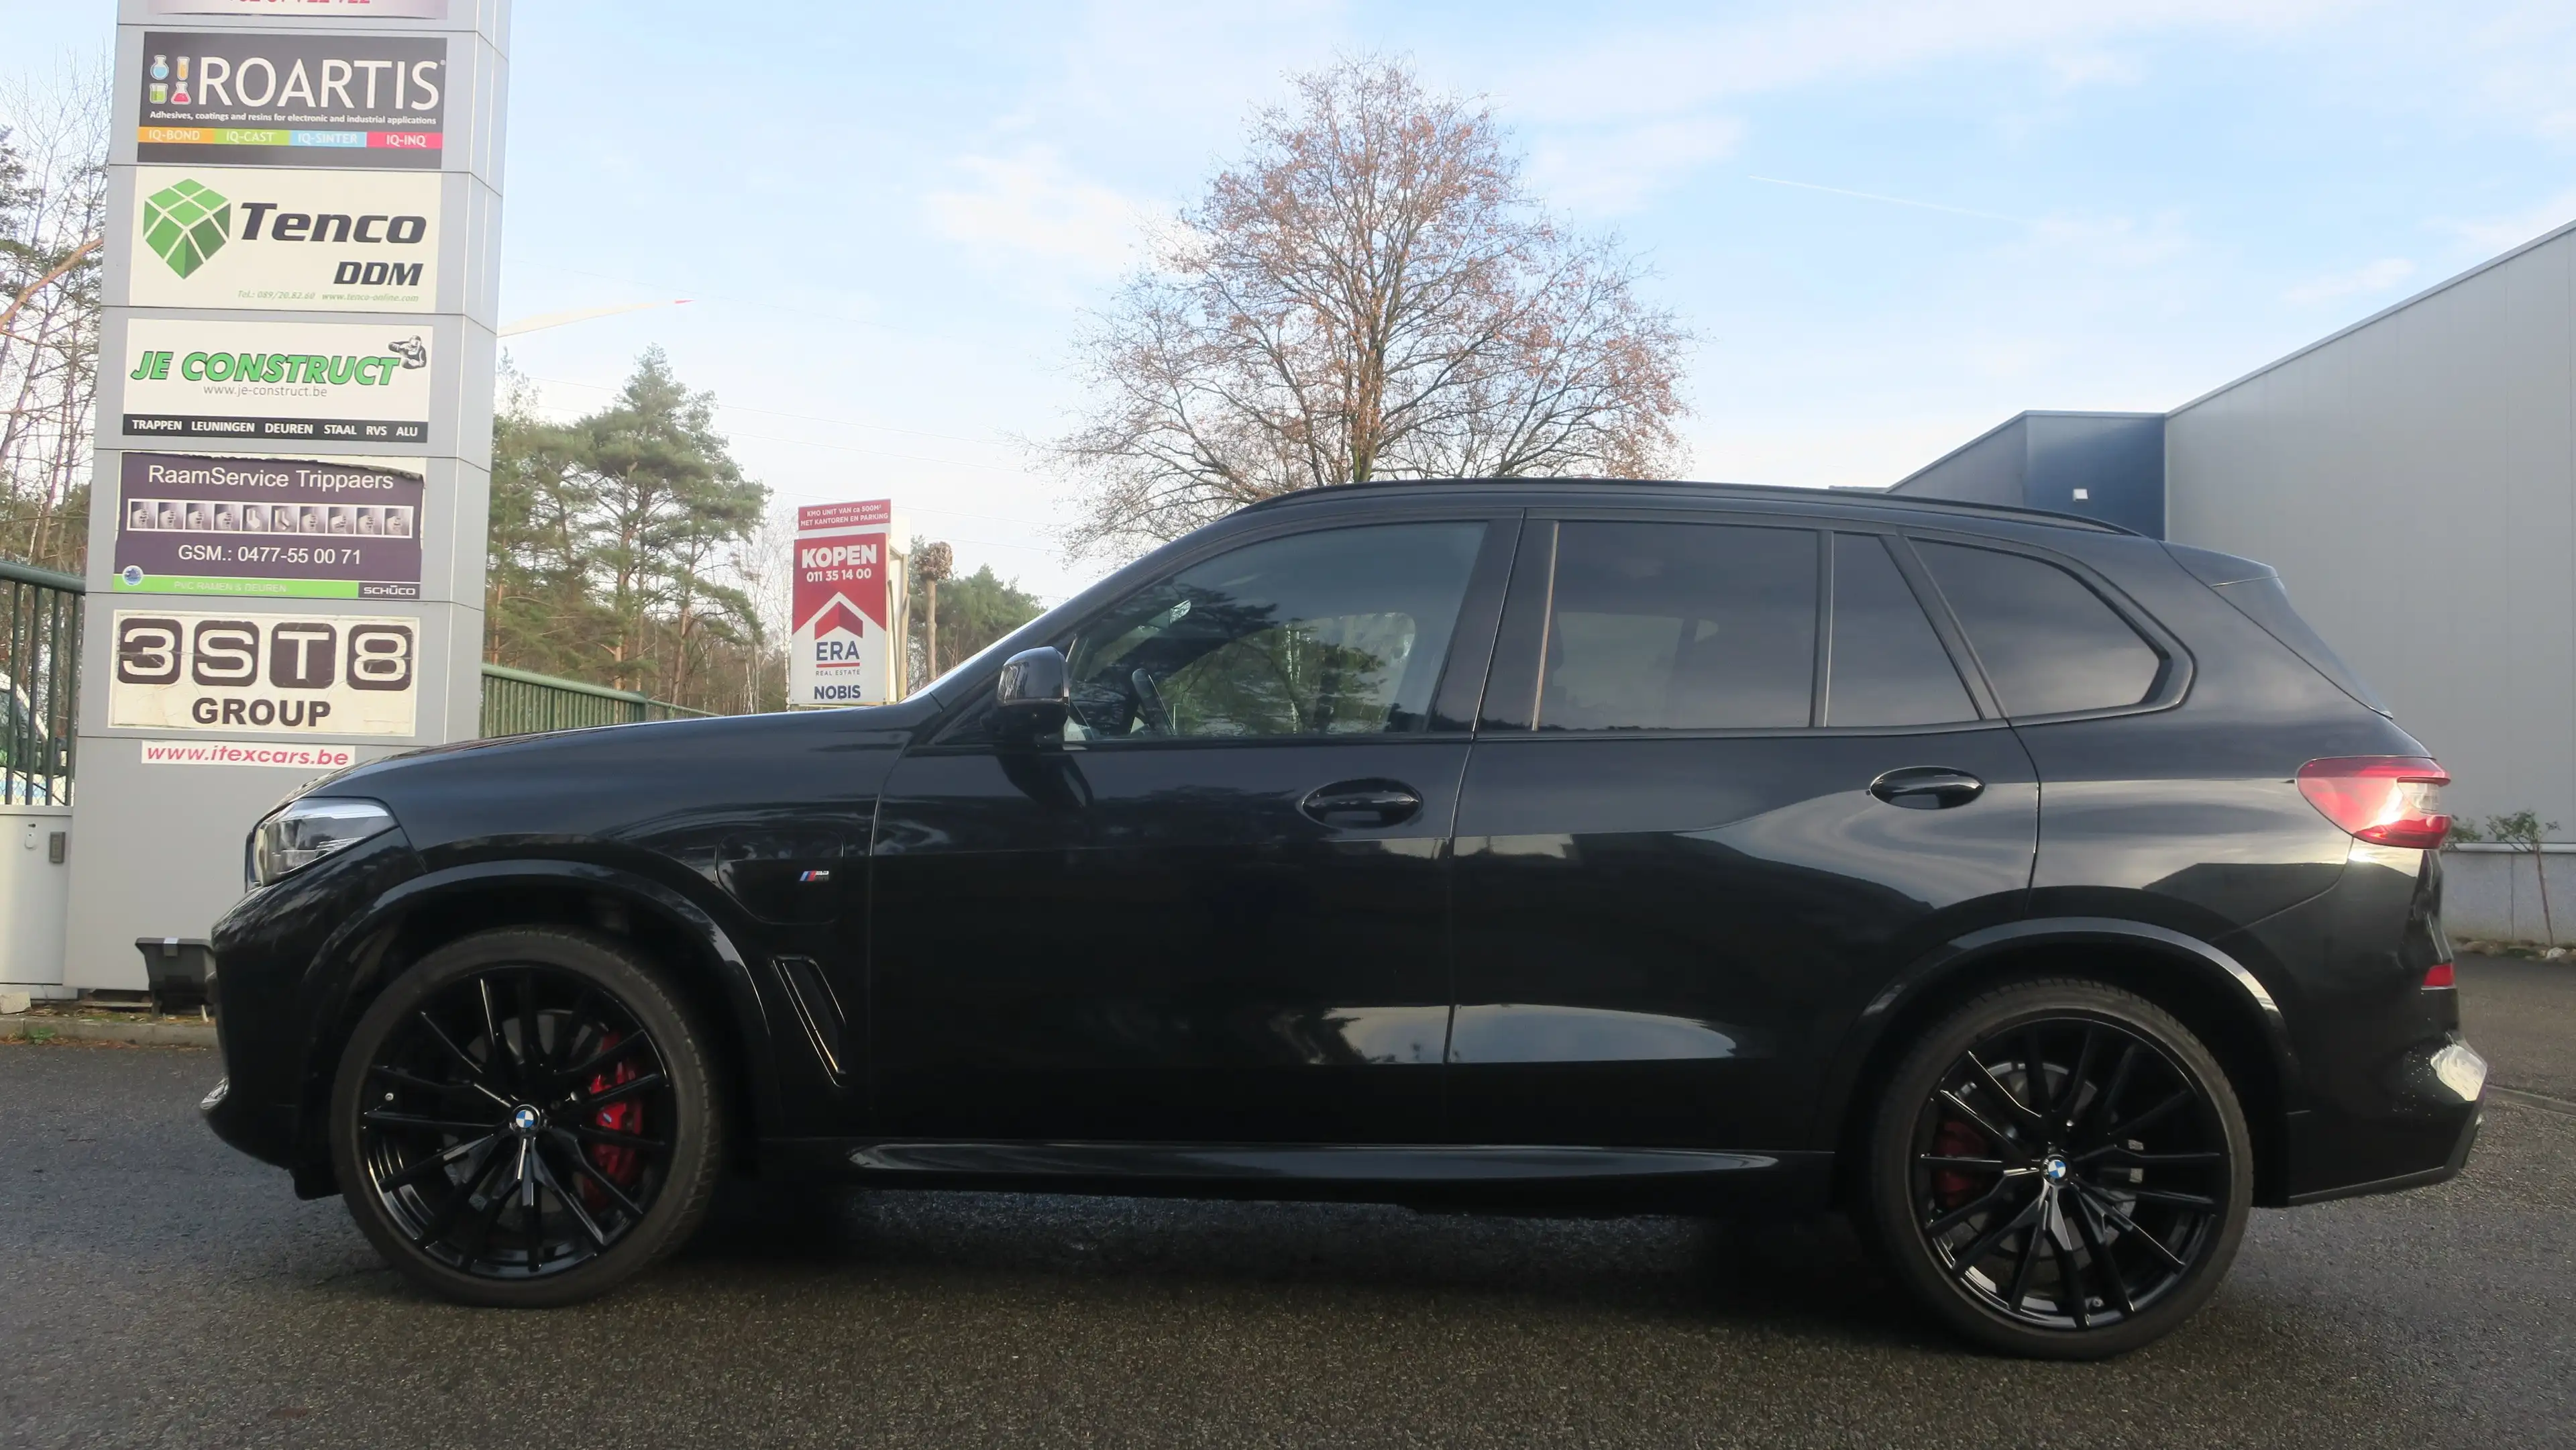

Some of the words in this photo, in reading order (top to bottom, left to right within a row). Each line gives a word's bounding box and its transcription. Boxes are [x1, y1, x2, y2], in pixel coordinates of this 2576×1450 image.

[199, 56, 439, 111] ROARTIS
[150, 111, 193, 121] Adhesives,
[195, 113, 229, 121] coatings
[231, 113, 246, 121] and
[248, 113, 272, 121] resins
[274, 113, 286, 122] for
[287, 114, 327, 122] electronic
[329, 115, 345, 123] and
[347, 115, 385, 123] industrial
[387, 116, 436, 125] applications
[149, 130, 200, 142] IQ-BOND
[226, 130, 275, 143] IQ-CAST
[298, 132, 358, 145] IQ-SINTER
[386, 134, 427, 148] IQ-INQ
[240, 202, 427, 244] Tenco
[333, 261, 423, 286] DDM
[322, 293, 419, 303] www.tenco-online.com
[130, 351, 174, 380] JE
[181, 352, 401, 386] CONSTRUCT
[203, 385, 328, 398] www.je-construct.be
[132, 419, 182, 431] TRAPPEN
[191, 421, 255, 433] LEUNINGEN
[265, 423, 313, 435] DEUREN
[324, 424, 357, 435] STAAL
[366, 425, 387, 436] RVS
[396, 426, 418, 437] ALU
[149, 465, 289, 488] RaamService
[297, 471, 394, 493] Trippaers
[814, 516, 849, 525] KANTOREN
[860, 513, 889, 521] PARKING
[178, 545, 232, 562] GSM.:
[237, 547, 309, 564] 0477-55
[313, 548, 335, 565] 00
[341, 550, 362, 566] 71
[802, 543, 877, 568] KOPEN
[806, 571, 823, 582] 011
[825, 570, 839, 581] 35
[841, 569, 853, 580] 14
[856, 568, 871, 579] 00
[245, 584, 287, 592] DEUREN
[816, 641, 860, 661] ERA
[814, 685, 861, 700] NOBIS
[192, 697, 331, 727] GROUP
[146, 745, 349, 766] www.itexcars.be
